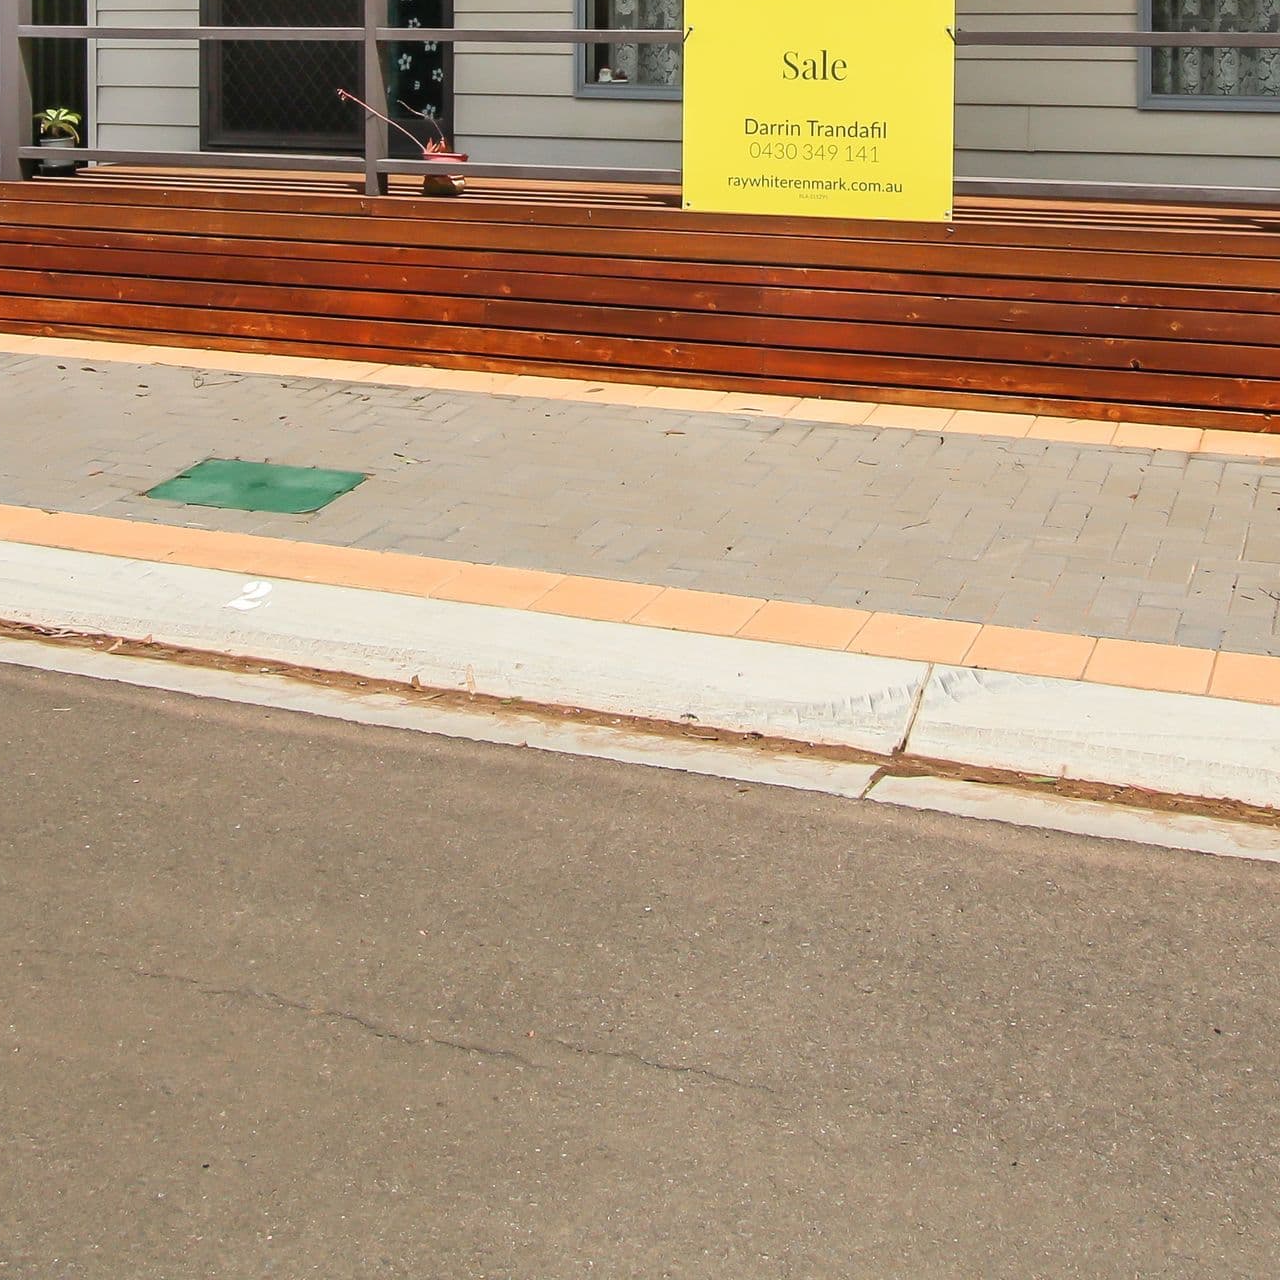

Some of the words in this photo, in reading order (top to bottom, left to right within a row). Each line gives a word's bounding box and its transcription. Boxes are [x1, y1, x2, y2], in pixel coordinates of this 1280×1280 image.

[782, 49, 848, 81] Sale
[744, 118, 801, 137] Darrin
[806, 120, 887, 139] Trandafil
[749, 141, 798, 160] 0430
[802, 143, 838, 161] 349
[845, 145, 880, 163] 141
[727, 174, 903, 194] raywhiterenmark.com.au
